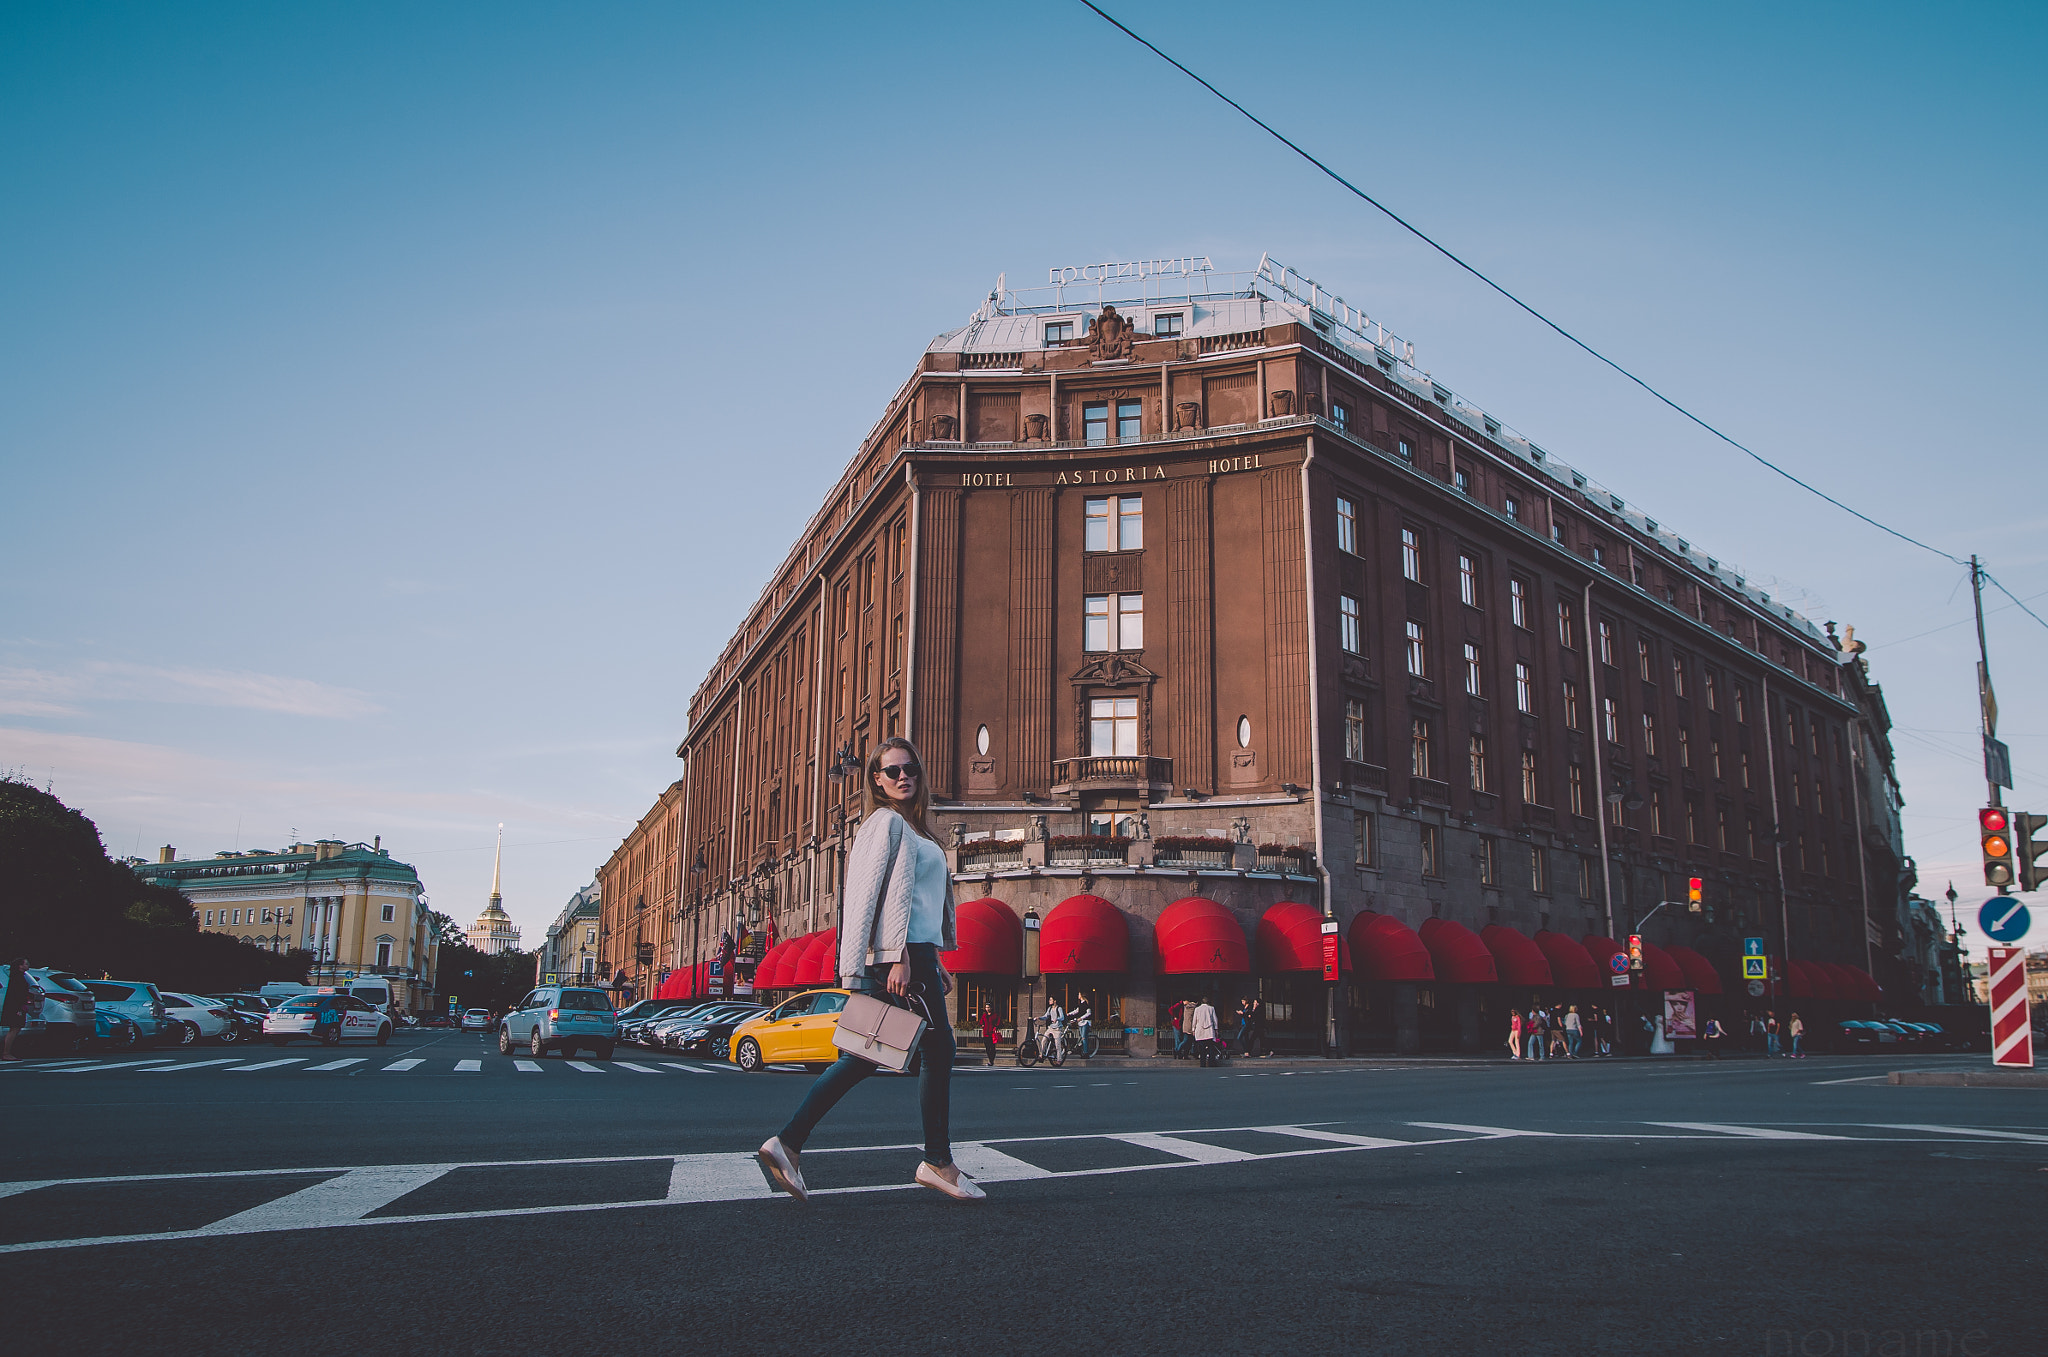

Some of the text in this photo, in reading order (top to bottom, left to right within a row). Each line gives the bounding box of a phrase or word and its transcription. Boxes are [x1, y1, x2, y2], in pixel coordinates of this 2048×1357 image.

[1049, 251, 1416, 370] ГОСТИНИЦА АСТОРИЯ
[962, 454, 1263, 487] HOTEL ASTORIA HOTEL
[345, 1015, 358, 1027] 20
